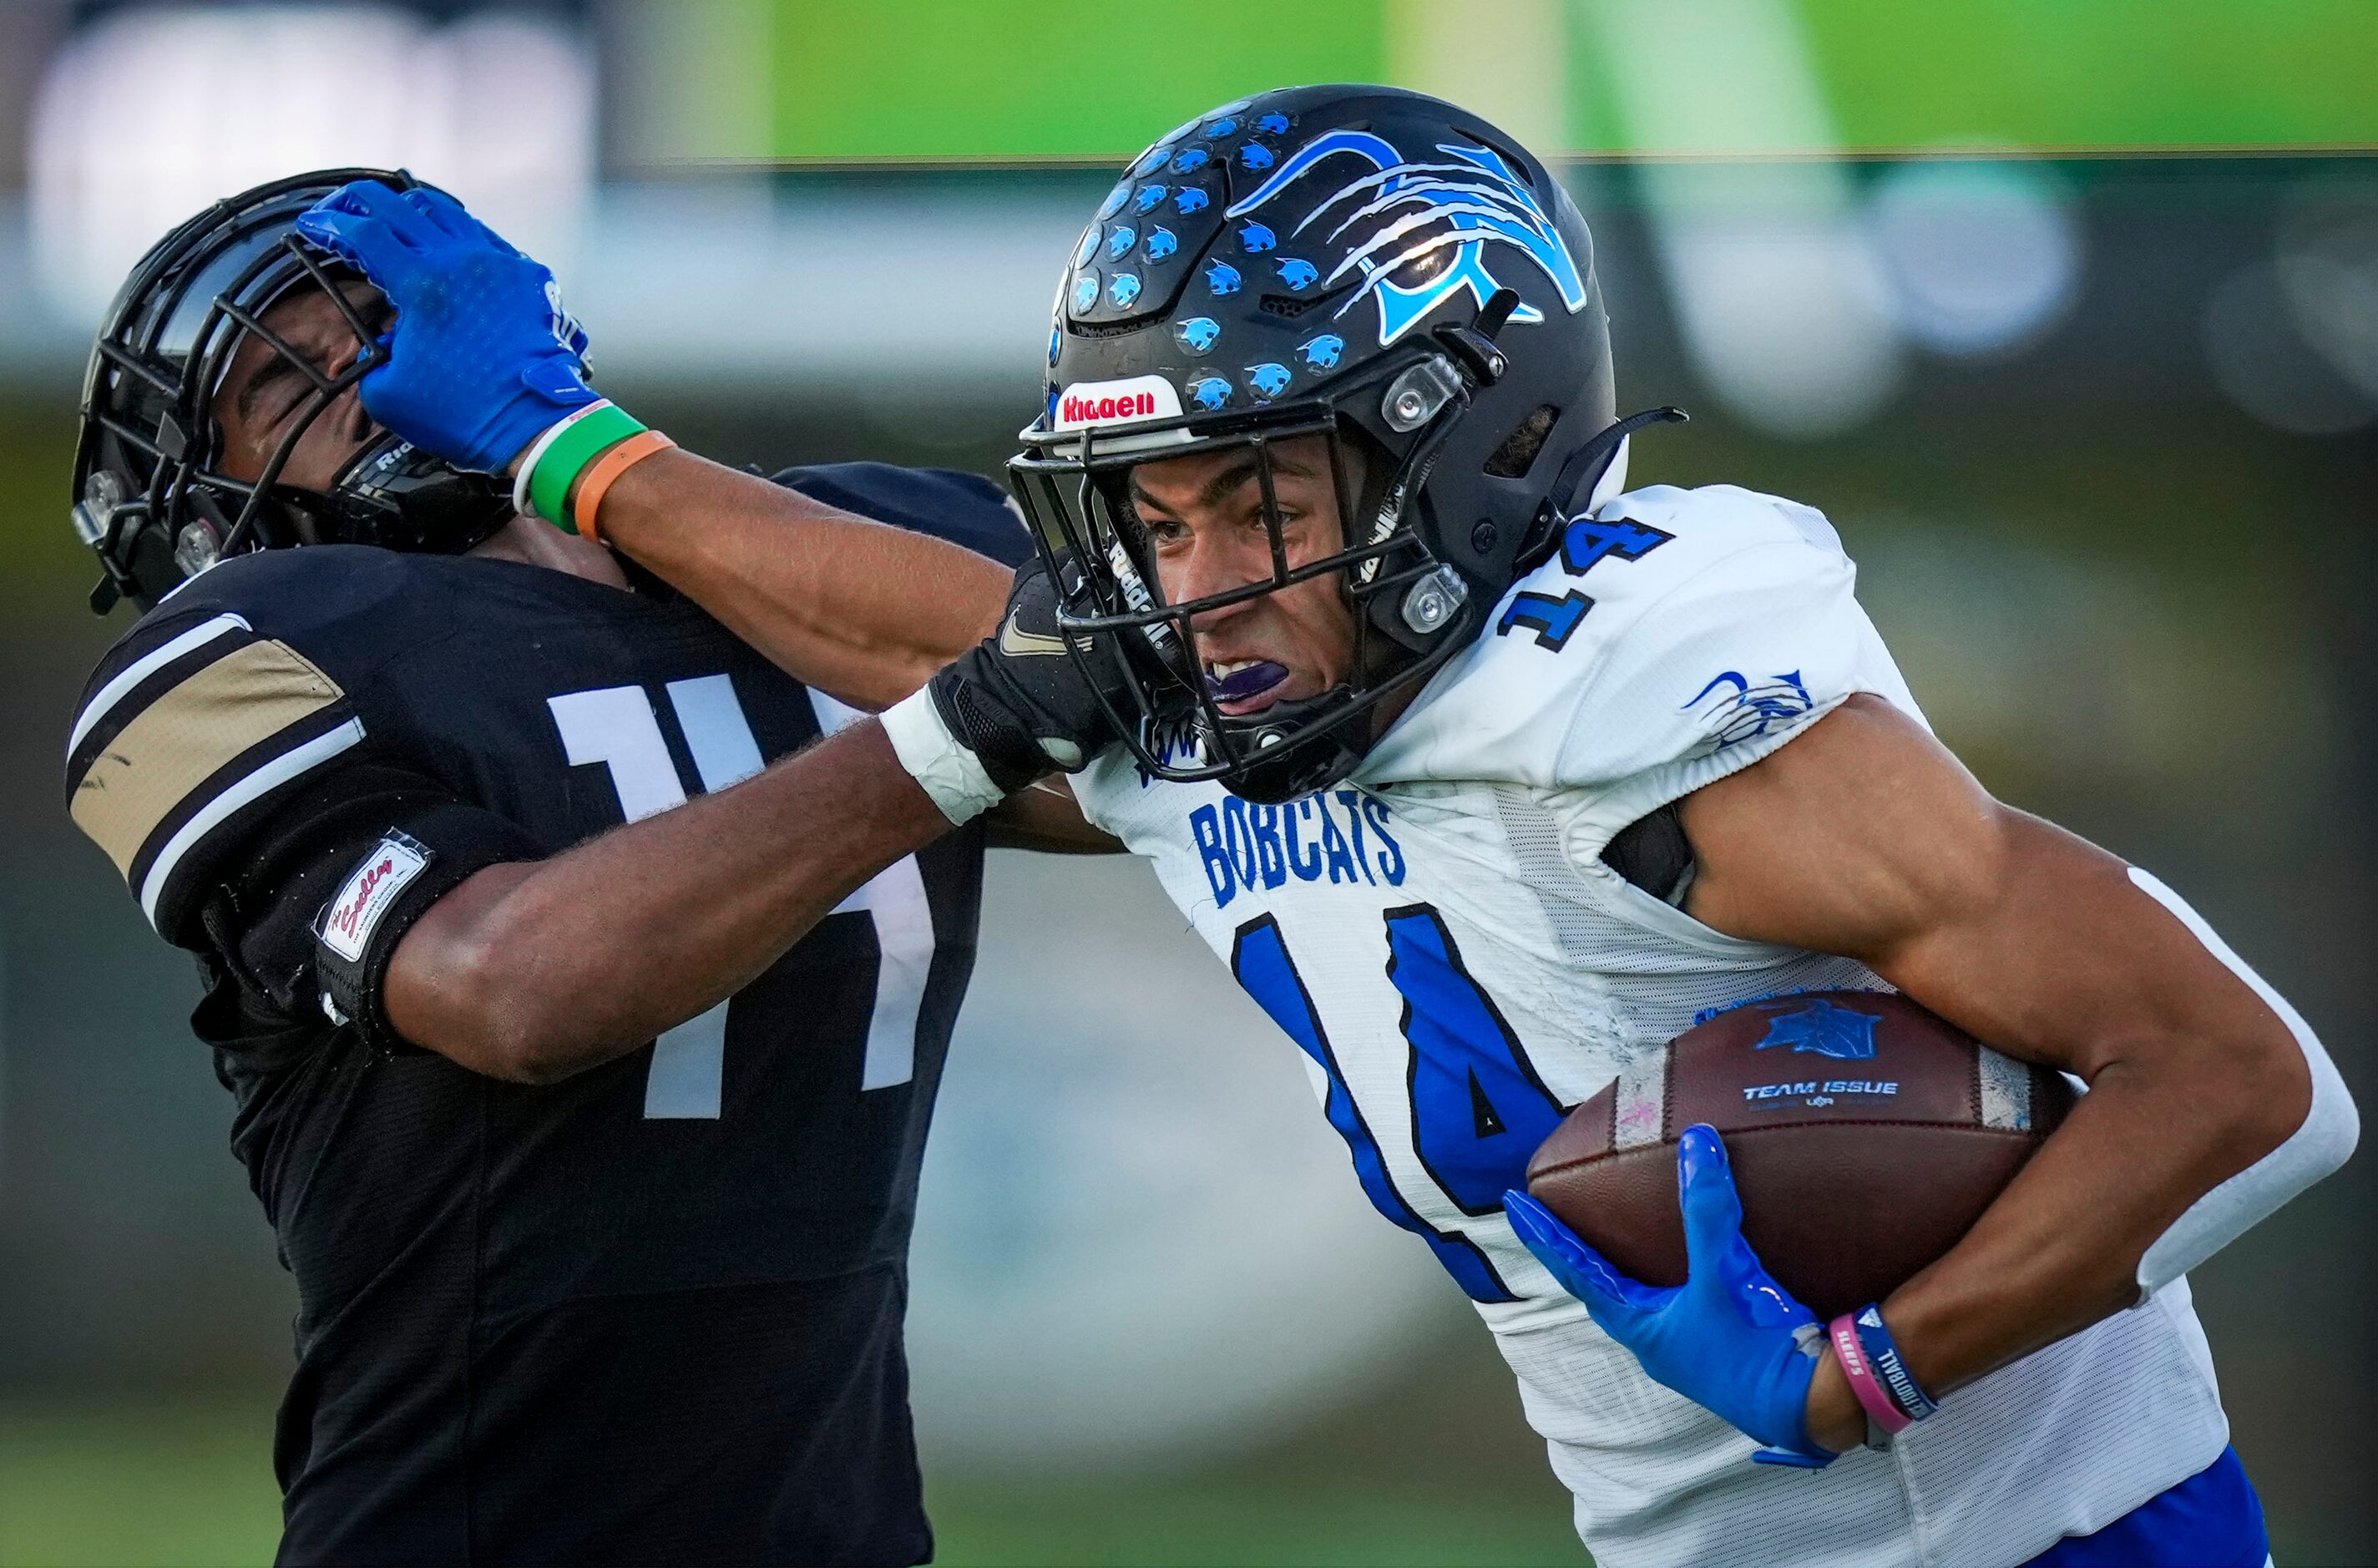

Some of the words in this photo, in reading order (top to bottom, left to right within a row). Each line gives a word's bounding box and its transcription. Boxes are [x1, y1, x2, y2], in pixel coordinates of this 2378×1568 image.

[1497, 517, 1677, 653] 14
[1189, 790, 1406, 908] BOBCATS
[341, 859, 393, 939] Sully
[1231, 902, 1581, 1303] 14
[1743, 1081, 1818, 1100] TEAM
[1822, 1081, 1898, 1095] ISSUE
[1878, 1348, 1921, 1407] FOOTBALL
